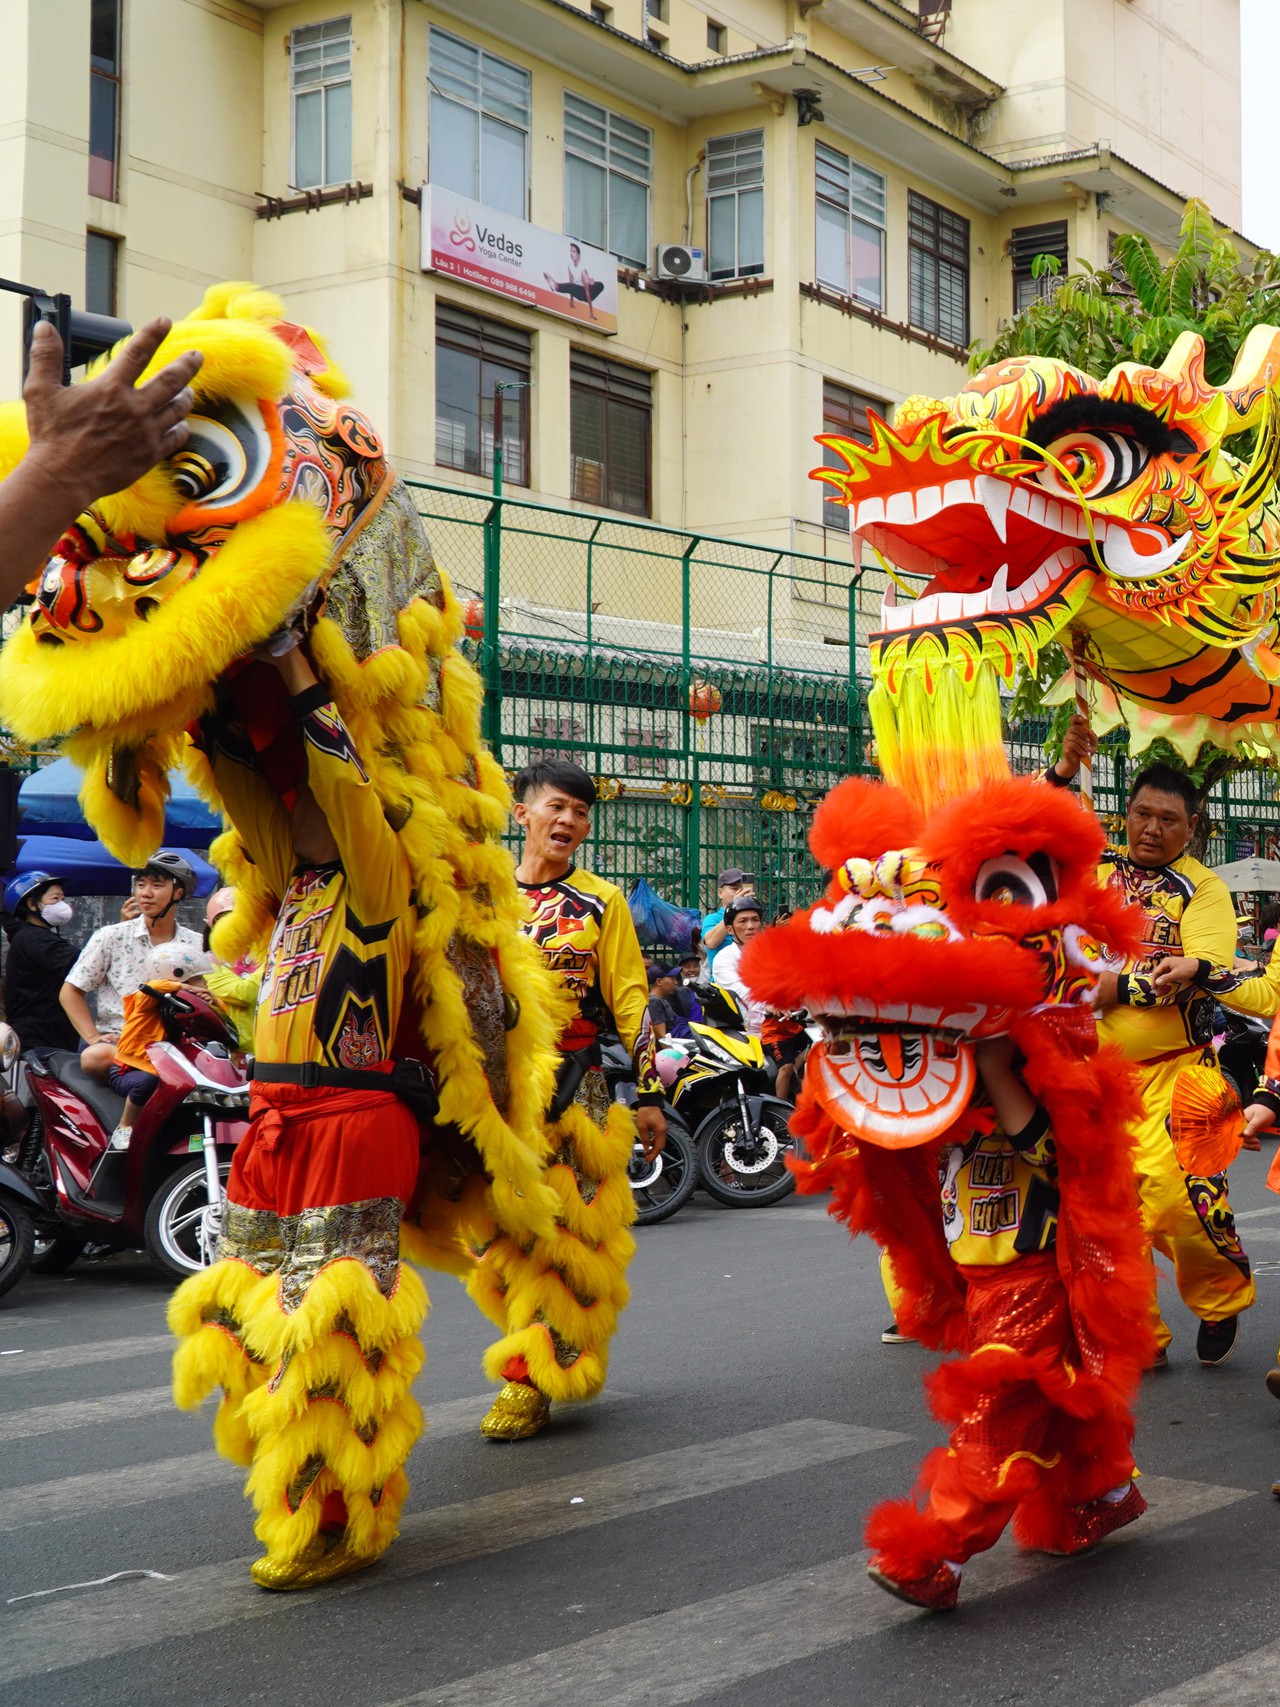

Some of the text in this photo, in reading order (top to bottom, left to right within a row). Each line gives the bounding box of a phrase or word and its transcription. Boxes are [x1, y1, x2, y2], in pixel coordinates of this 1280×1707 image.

[475, 224, 523, 258] Vedas
[479, 246, 522, 267] Yoga Center
[449, 262, 455, 270] 3
[463, 267, 489, 282] Hotline:
[490, 277, 503, 287] 089
